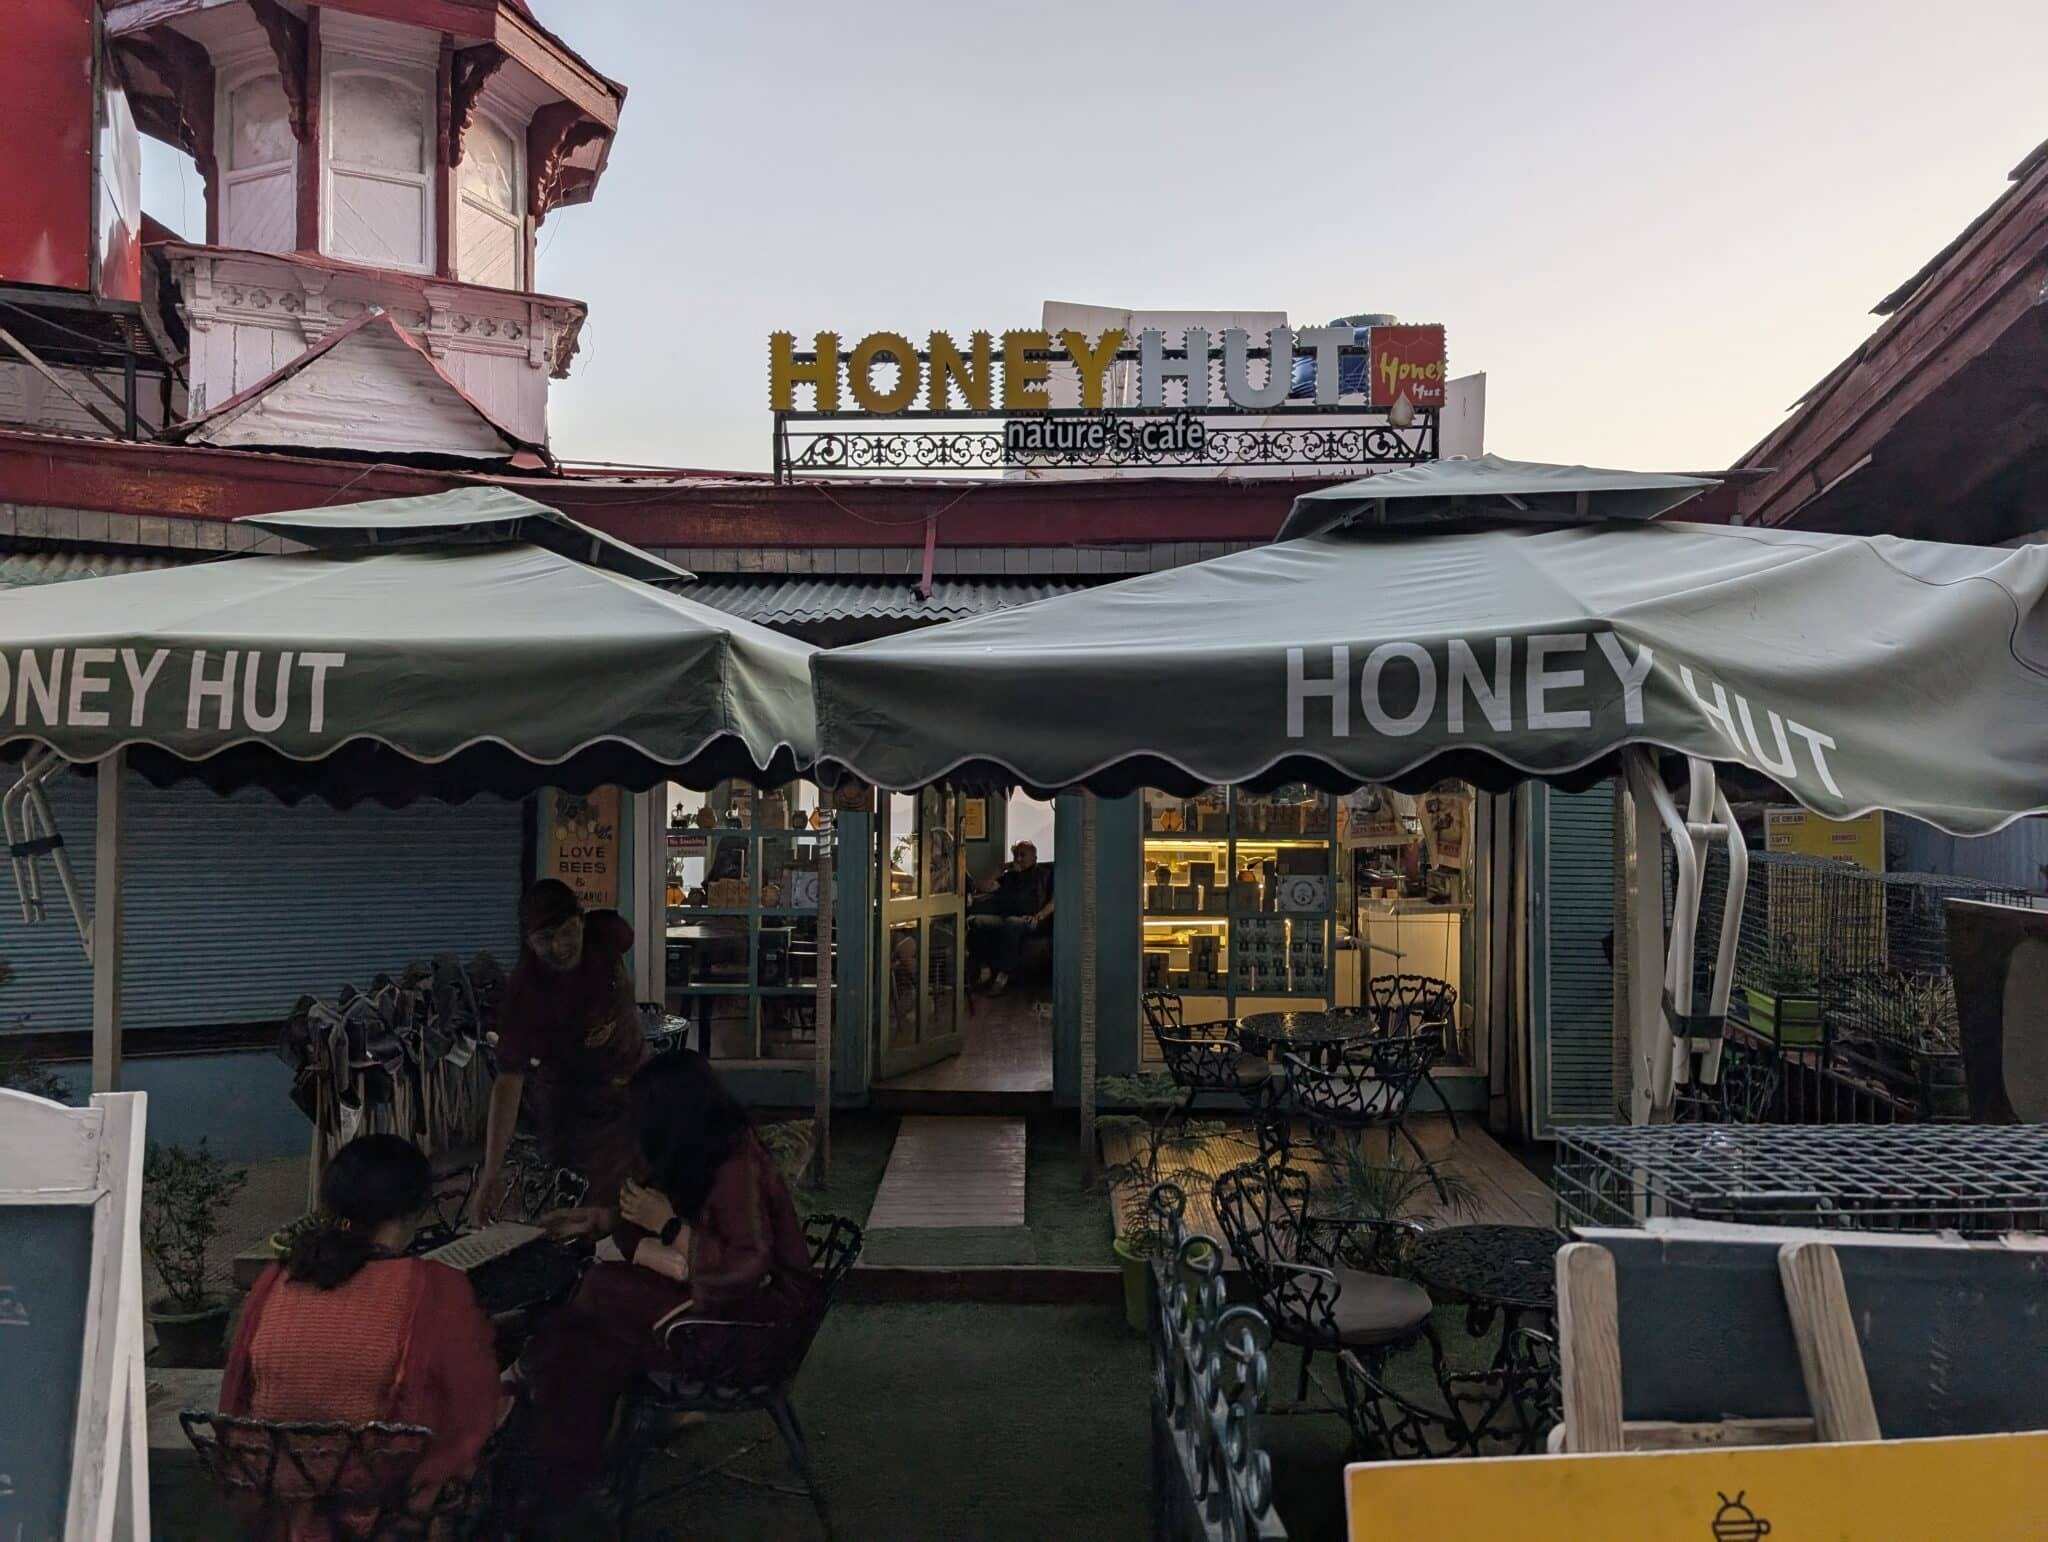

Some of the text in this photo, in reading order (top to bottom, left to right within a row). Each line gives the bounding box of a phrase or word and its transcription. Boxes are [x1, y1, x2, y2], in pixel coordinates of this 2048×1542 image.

[770, 327, 1356, 413] HONEY HUT
[1379, 352, 1446, 396] Honey
[1412, 383, 1441, 399] Hut
[1006, 414, 1203, 450] nature's cafe
[0, 648, 346, 733] NEY HUT
[1285, 632, 1844, 799] HONEY HUT
[559, 846, 606, 858] LOVE
[559, 861, 607, 874] BEES
